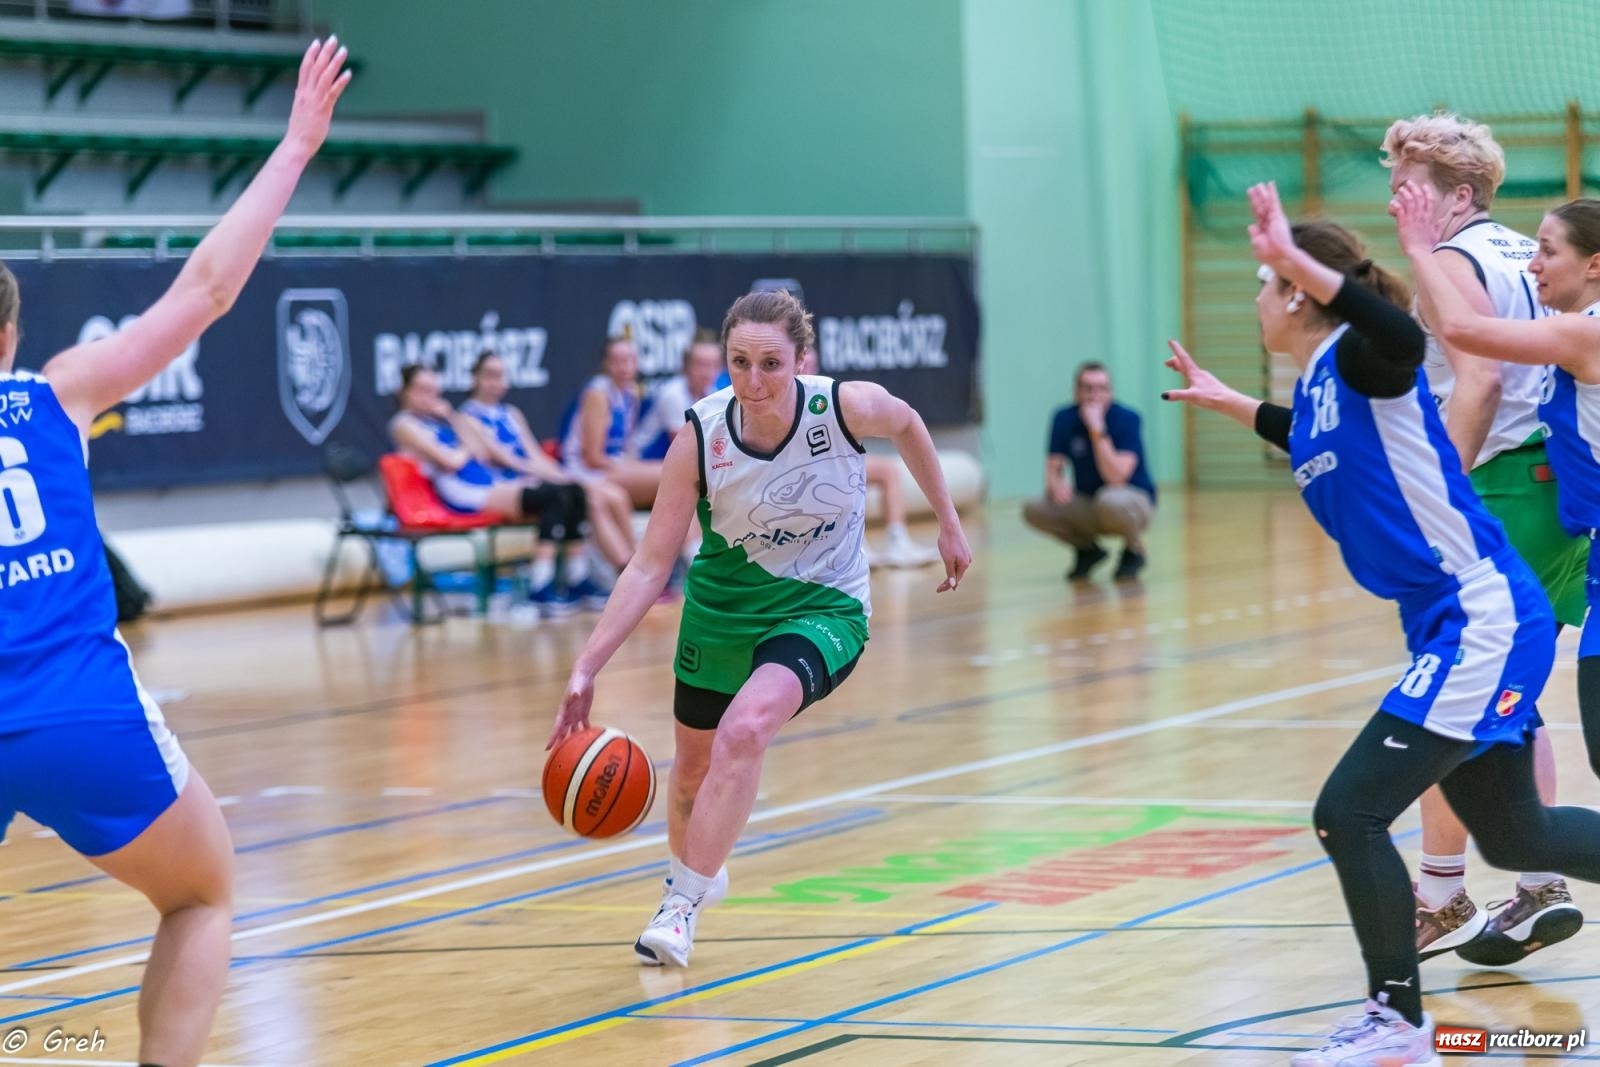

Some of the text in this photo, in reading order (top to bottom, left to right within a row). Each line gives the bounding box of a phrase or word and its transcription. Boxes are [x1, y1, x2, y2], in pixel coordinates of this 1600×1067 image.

[806, 424, 832, 457] 9
[0, 548, 75, 590] ARD
[585, 754, 622, 818] molten
